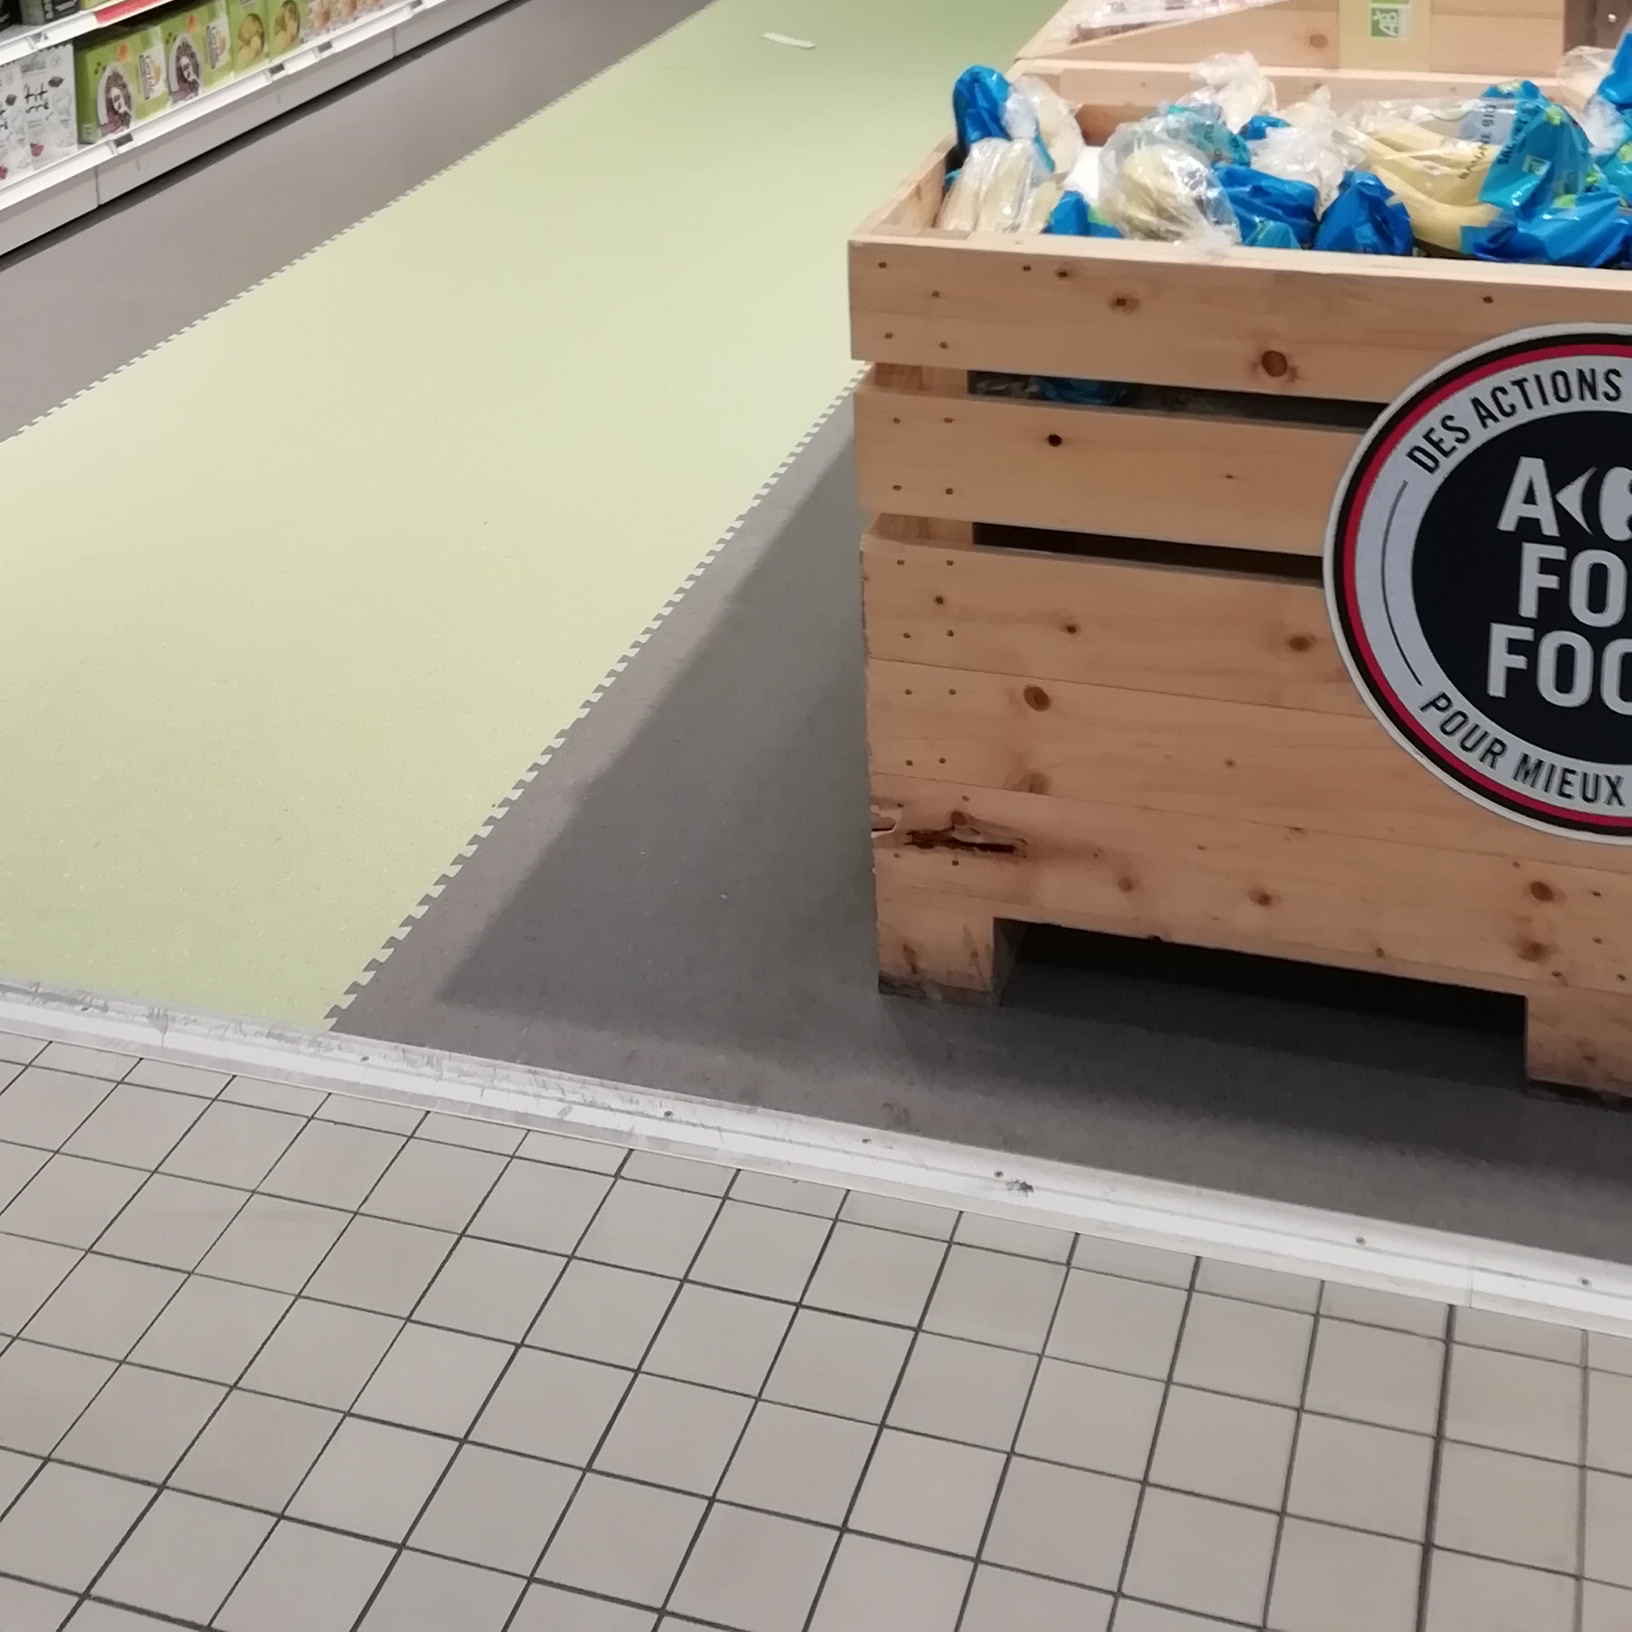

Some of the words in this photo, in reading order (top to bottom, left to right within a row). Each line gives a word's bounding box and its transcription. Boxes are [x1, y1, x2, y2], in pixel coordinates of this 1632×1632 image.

[1406, 416, 1472, 476] DES
[1471, 366, 1623, 434] ACTIONS
[1419, 690, 1509, 773] POUR
[1511, 751, 1628, 808] MIEUX
